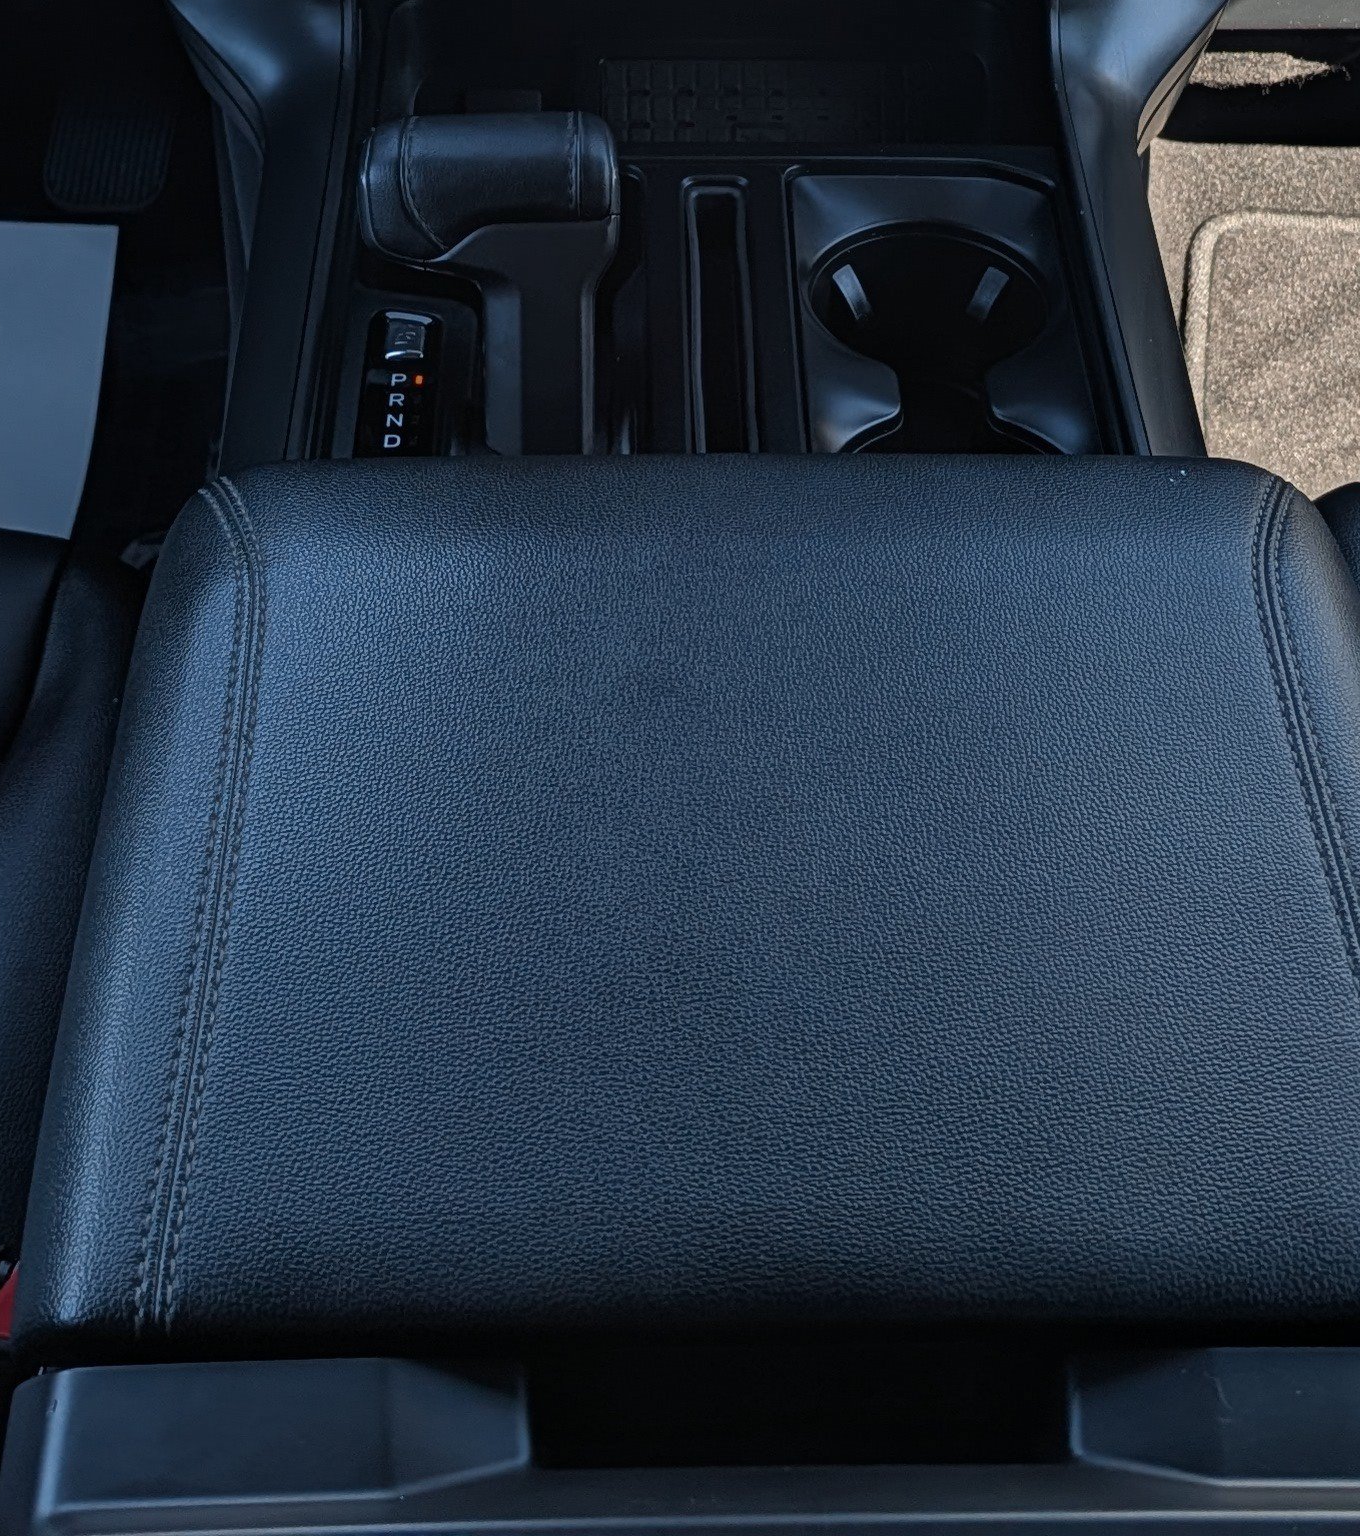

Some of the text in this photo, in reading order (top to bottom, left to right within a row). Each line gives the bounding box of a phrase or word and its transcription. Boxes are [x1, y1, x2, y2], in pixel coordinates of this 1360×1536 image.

[391, 373, 407, 387] P
[388, 393, 405, 407] R
[385, 413, 404, 427] N
[383, 434, 401, 449] D
